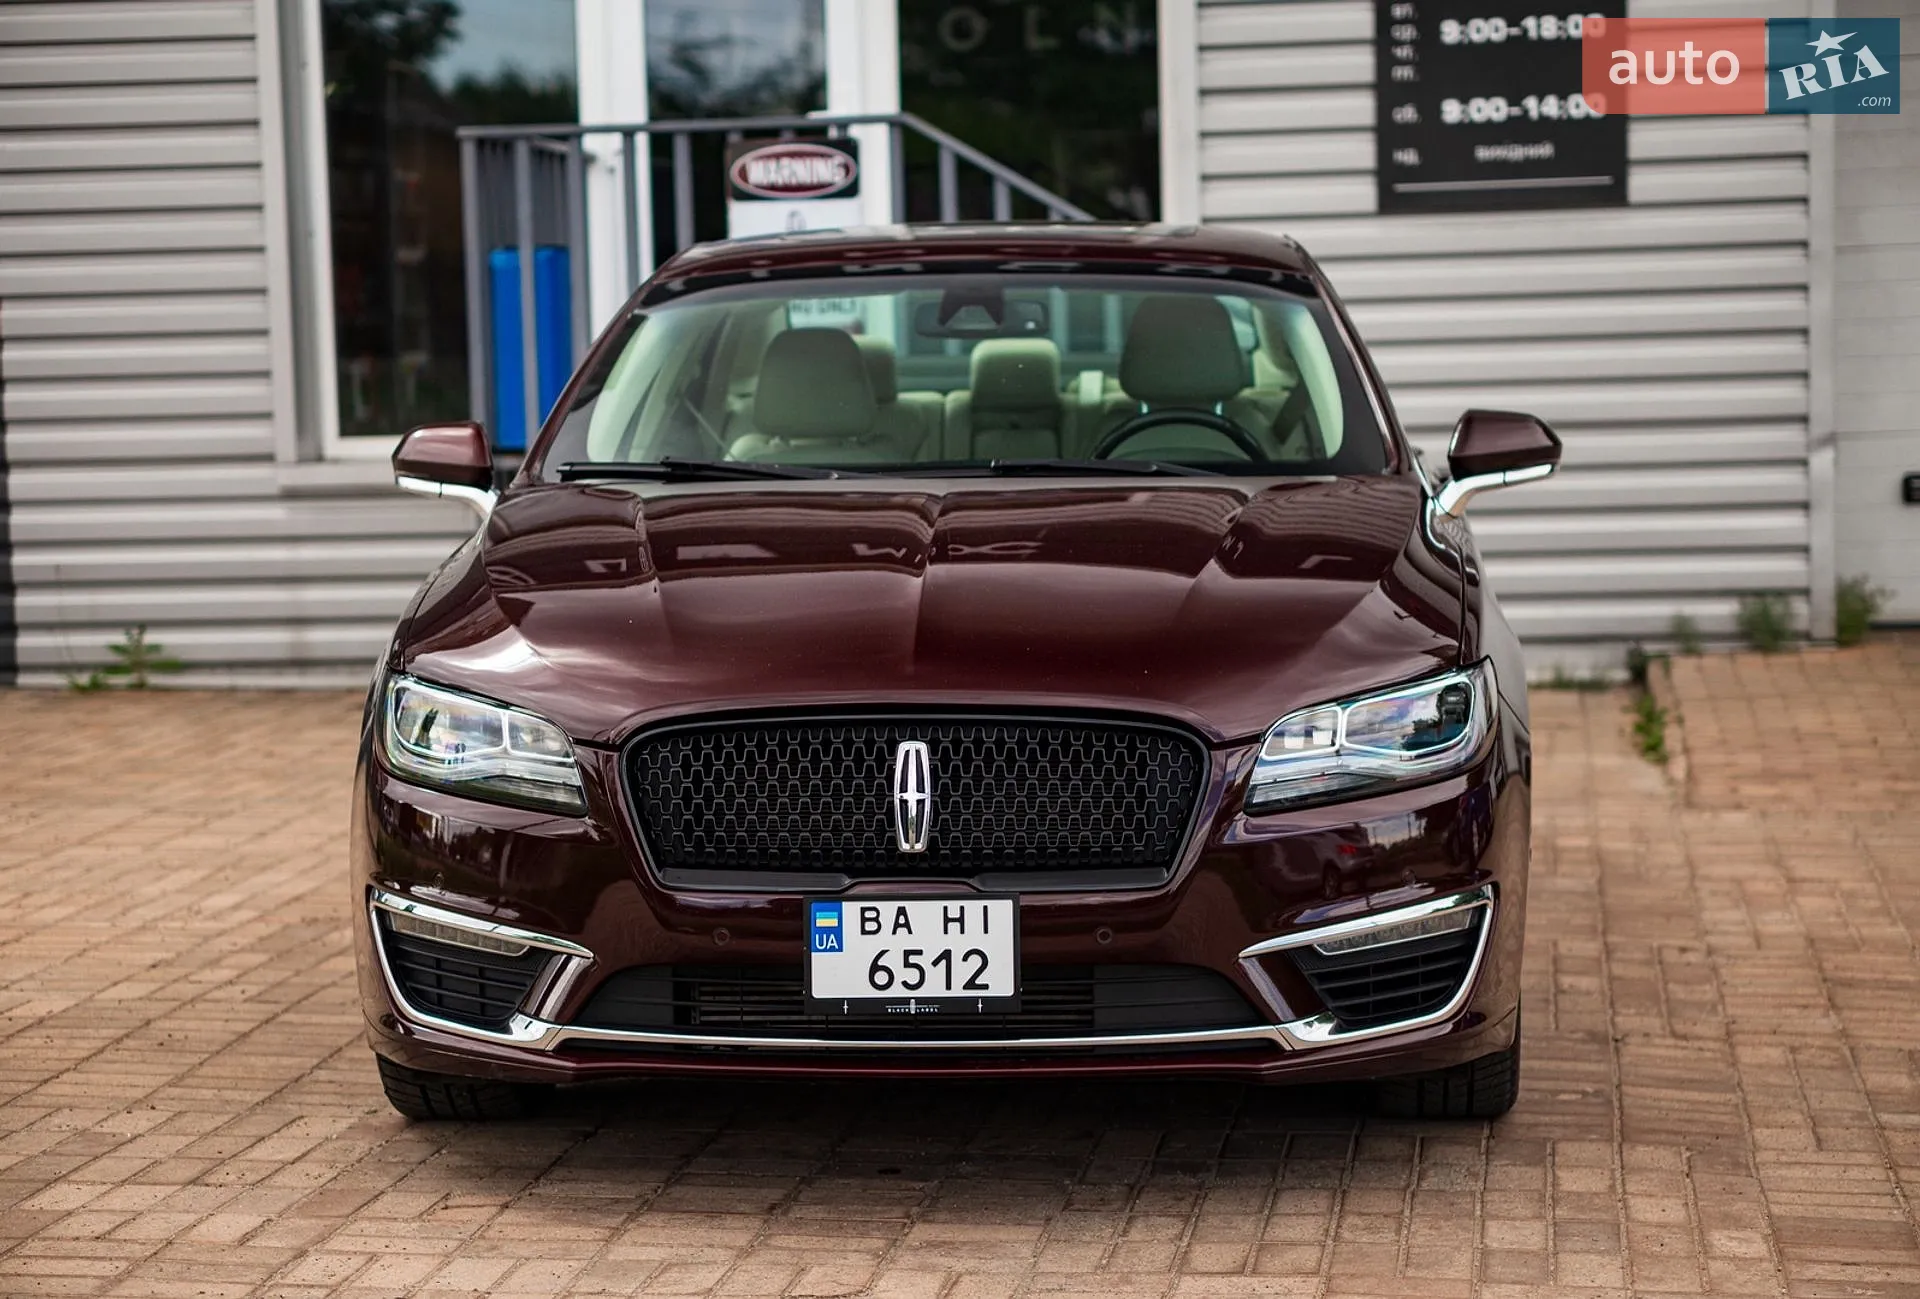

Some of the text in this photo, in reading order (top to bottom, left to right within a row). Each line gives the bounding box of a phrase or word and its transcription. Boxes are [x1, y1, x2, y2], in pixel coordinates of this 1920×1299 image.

[747, 156, 848, 185] WARNING
[860, 905, 989, 935] BA HI
[815, 934, 839, 950] UA
[868, 948, 990, 991] 6512
